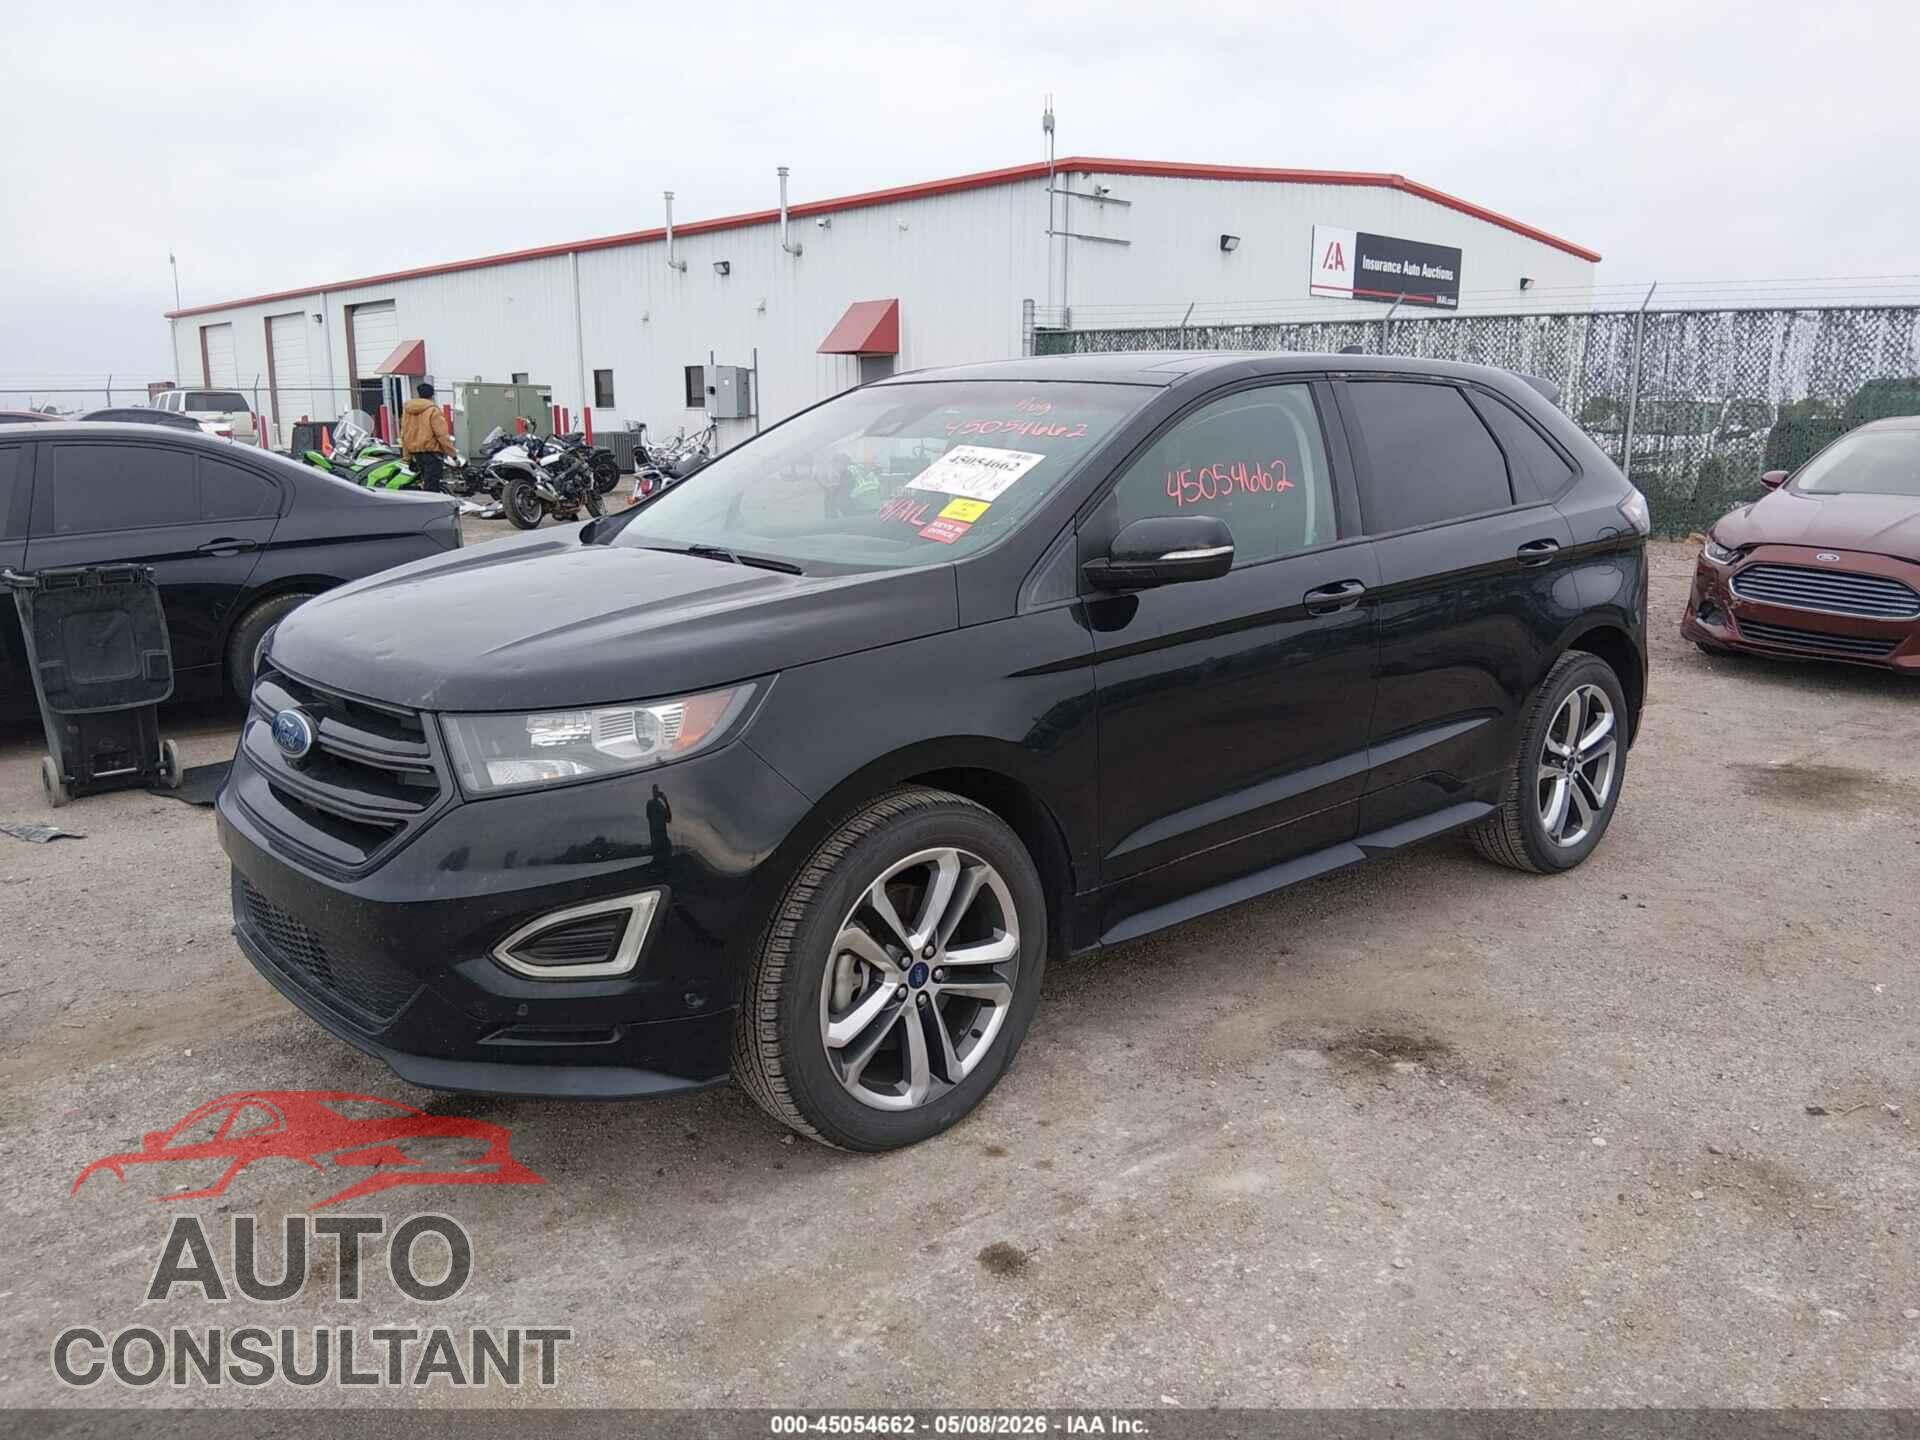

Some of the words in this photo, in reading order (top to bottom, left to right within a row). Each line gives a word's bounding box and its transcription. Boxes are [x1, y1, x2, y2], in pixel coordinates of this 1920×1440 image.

[1362, 254, 1401, 274] Insurance
[1403, 260, 1420, 277] Auto
[1421, 264, 1454, 281] Auctions
[1167, 460, 1295, 507] 45054662
